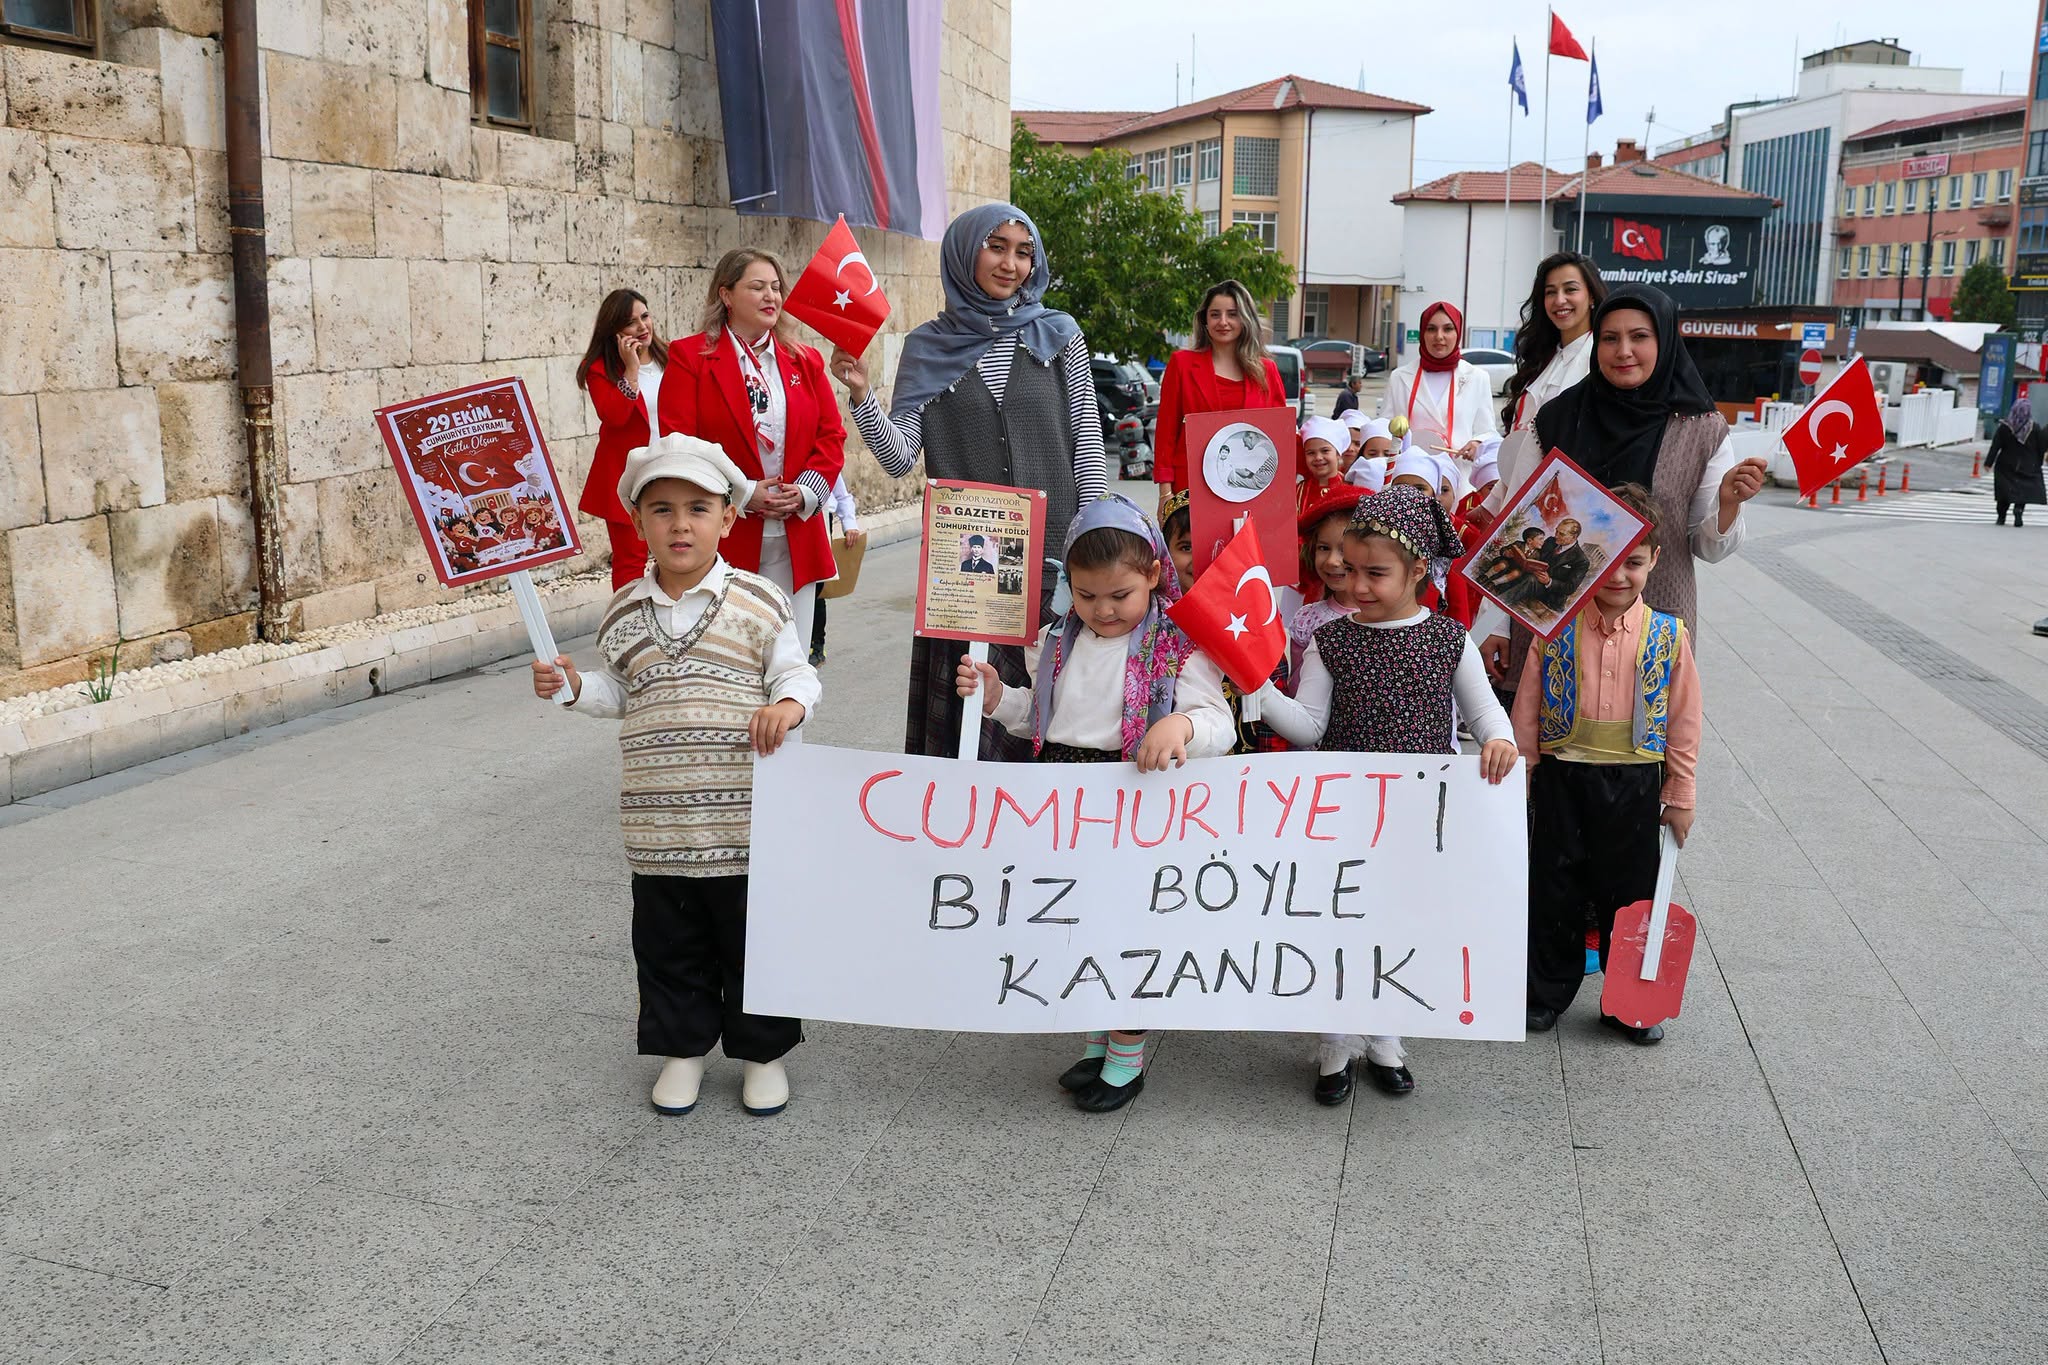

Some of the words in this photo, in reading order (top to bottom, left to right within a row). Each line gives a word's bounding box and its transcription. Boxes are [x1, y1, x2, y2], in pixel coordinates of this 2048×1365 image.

[1598, 268, 1667, 284] umhuriyet
[1669, 269, 1702, 285] Şehri
[1681, 320, 1758, 336] GÜVENLİK
[426, 413, 451, 435] 29
[451, 404, 493, 427] EKİM
[425, 428, 471, 447] CUMHURİYET
[472, 421, 504, 433] BAYRAMI
[443, 440, 470, 458] Kutlu
[470, 435, 499, 450] Olsun
[940, 492, 980, 503] YAZIYOOR
[981, 496, 1020, 506] YAZIYOOR
[954, 506, 1006, 520] GAZETE
[935, 521, 984, 532] CUMHURİYET
[985, 525, 1003, 534] İLAN
[1004, 527, 1029, 536] EDİLDİ
[929, 865, 1080, 930] BİZ
[1149, 850, 1366, 919] BÖYLE
